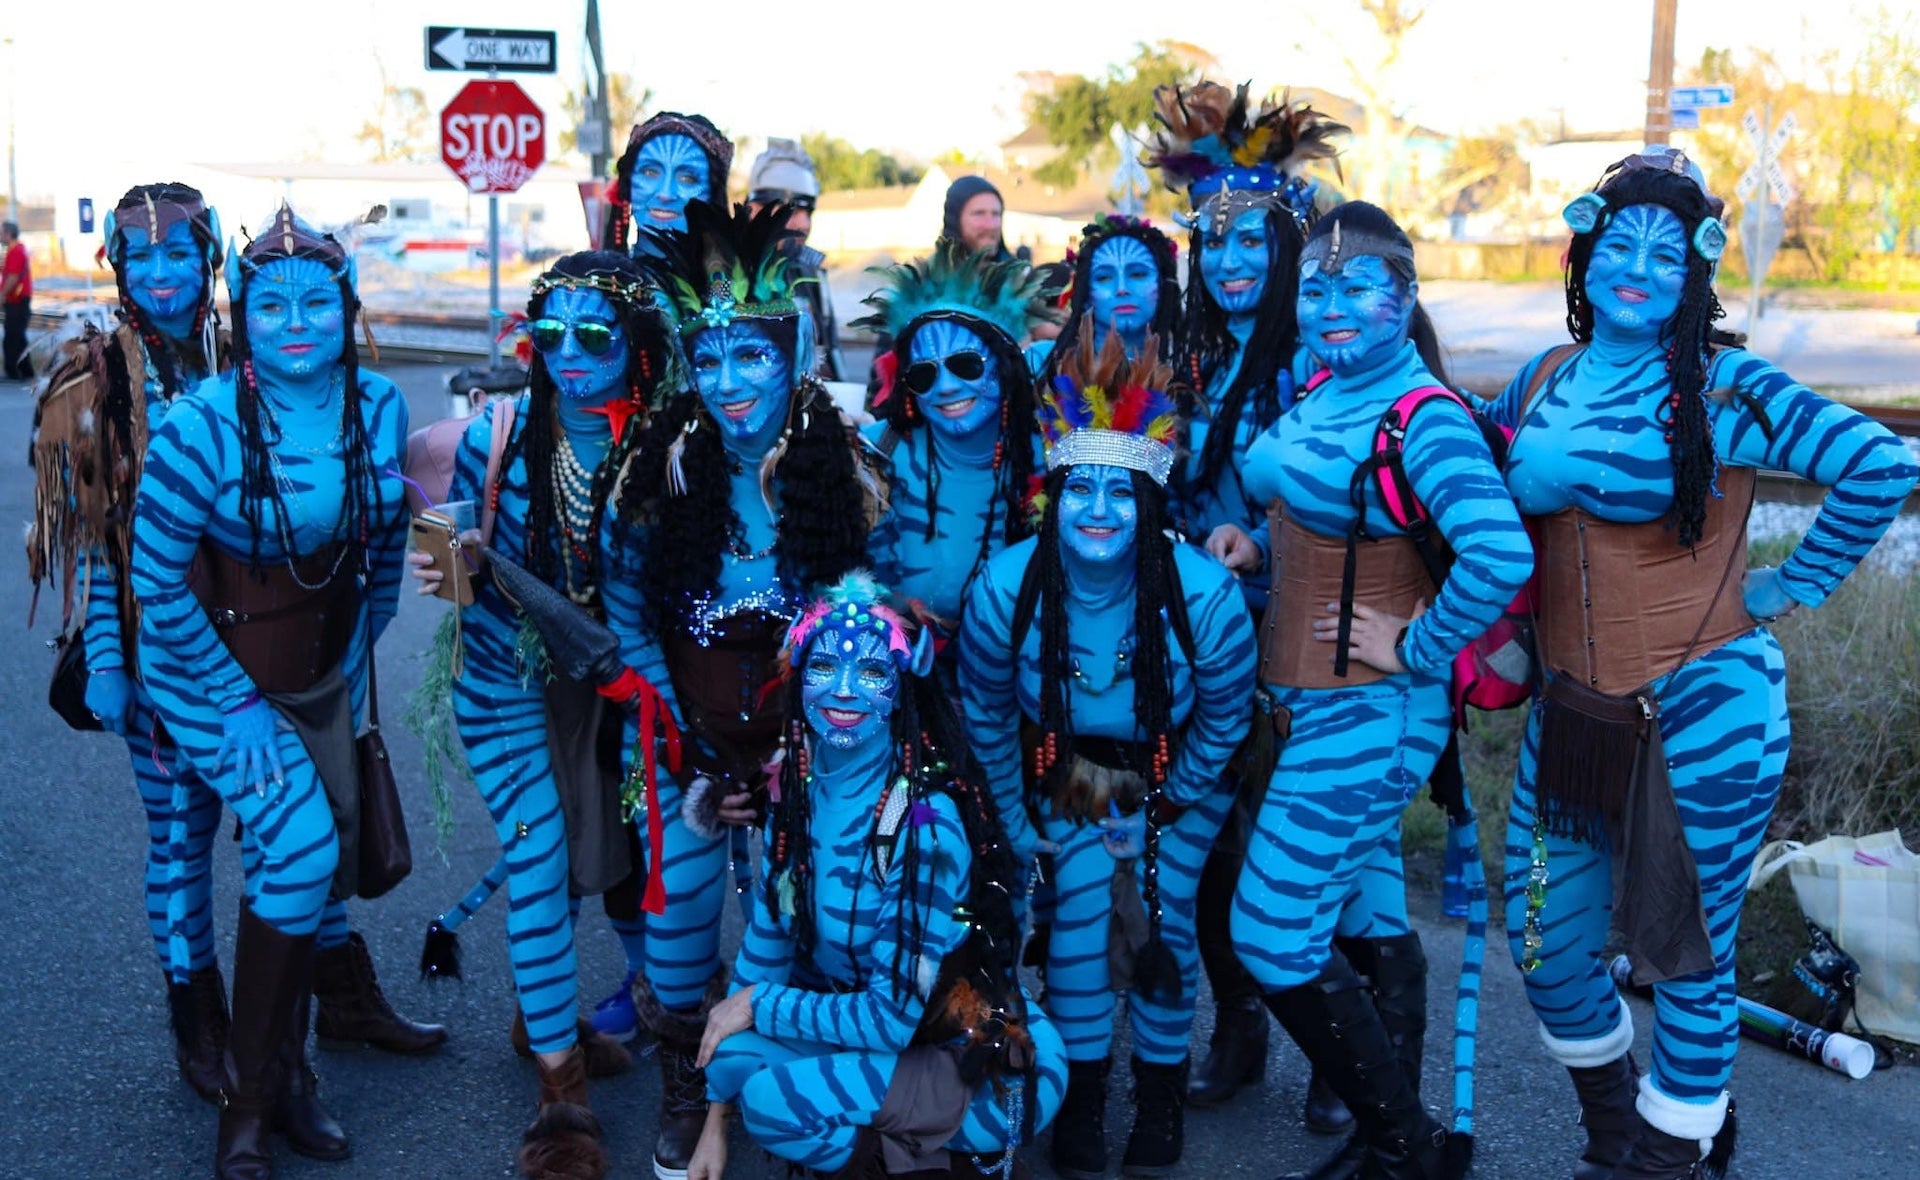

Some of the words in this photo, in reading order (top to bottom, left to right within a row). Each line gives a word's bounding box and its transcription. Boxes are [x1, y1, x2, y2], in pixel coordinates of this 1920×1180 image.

[466, 41, 502, 58] ONE
[510, 41, 544, 58] WAY
[446, 113, 541, 159] STOP
